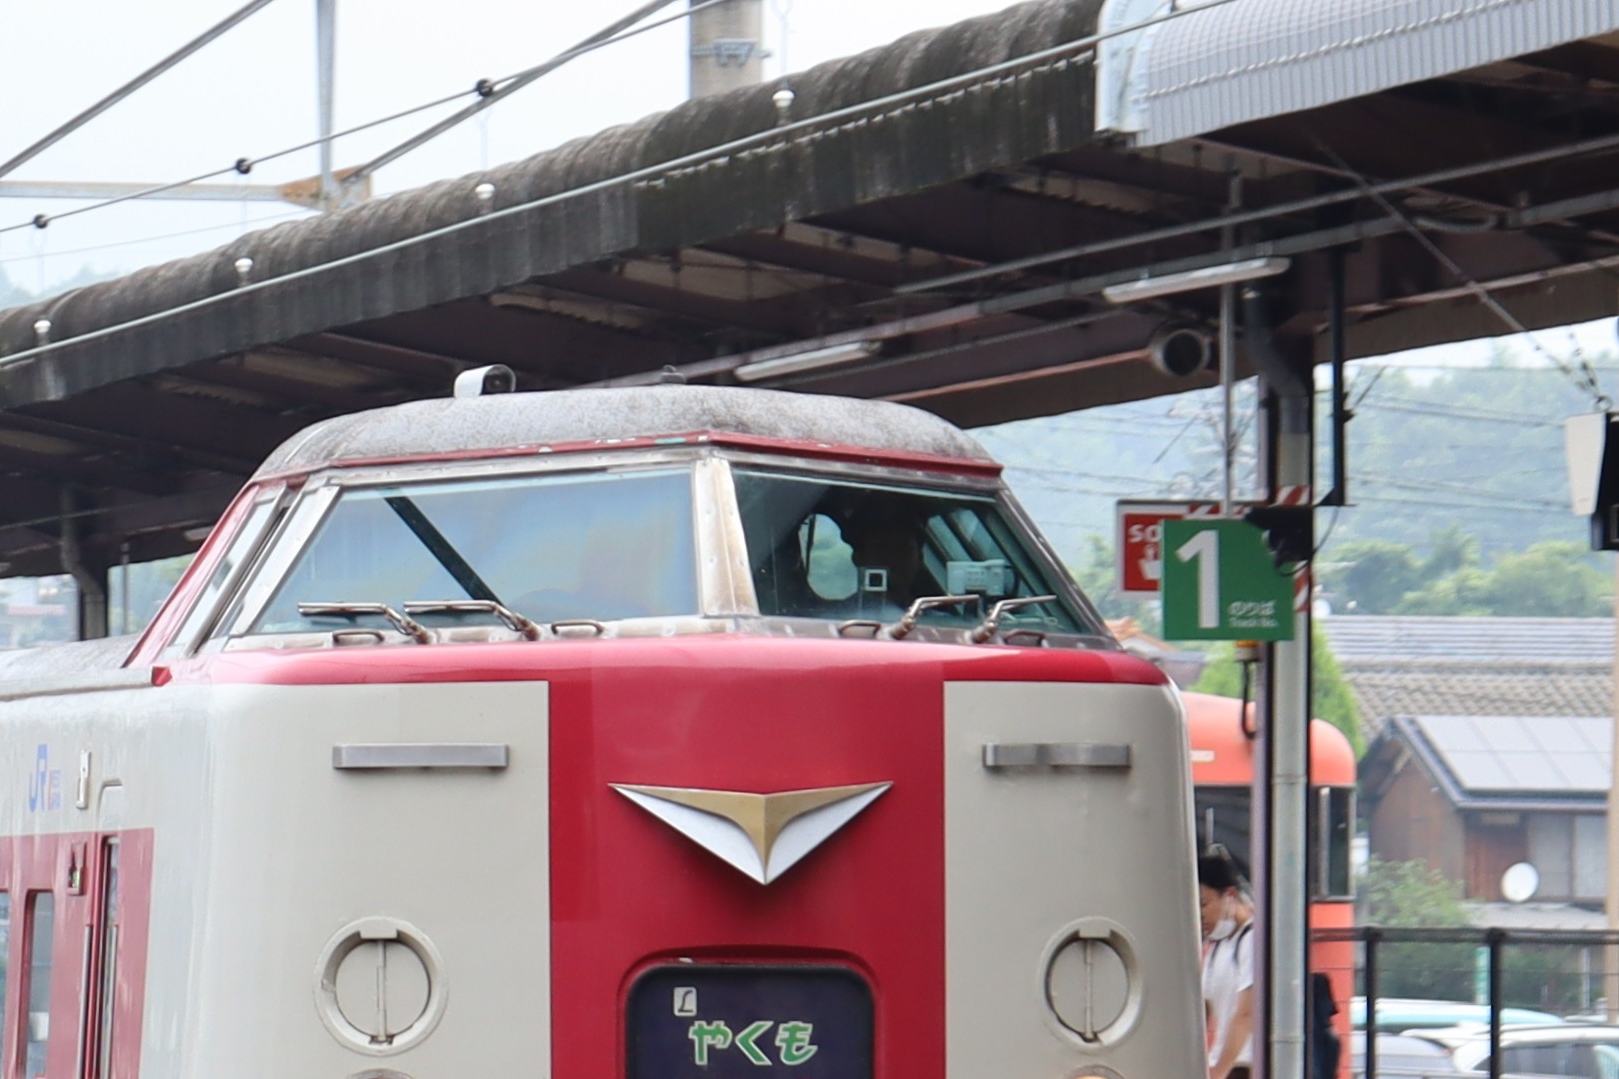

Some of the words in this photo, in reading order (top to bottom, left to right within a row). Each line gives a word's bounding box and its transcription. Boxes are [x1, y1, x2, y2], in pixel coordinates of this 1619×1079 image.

[1175, 529, 1220, 629] 1
[688, 1020, 819, 1066] やくも
